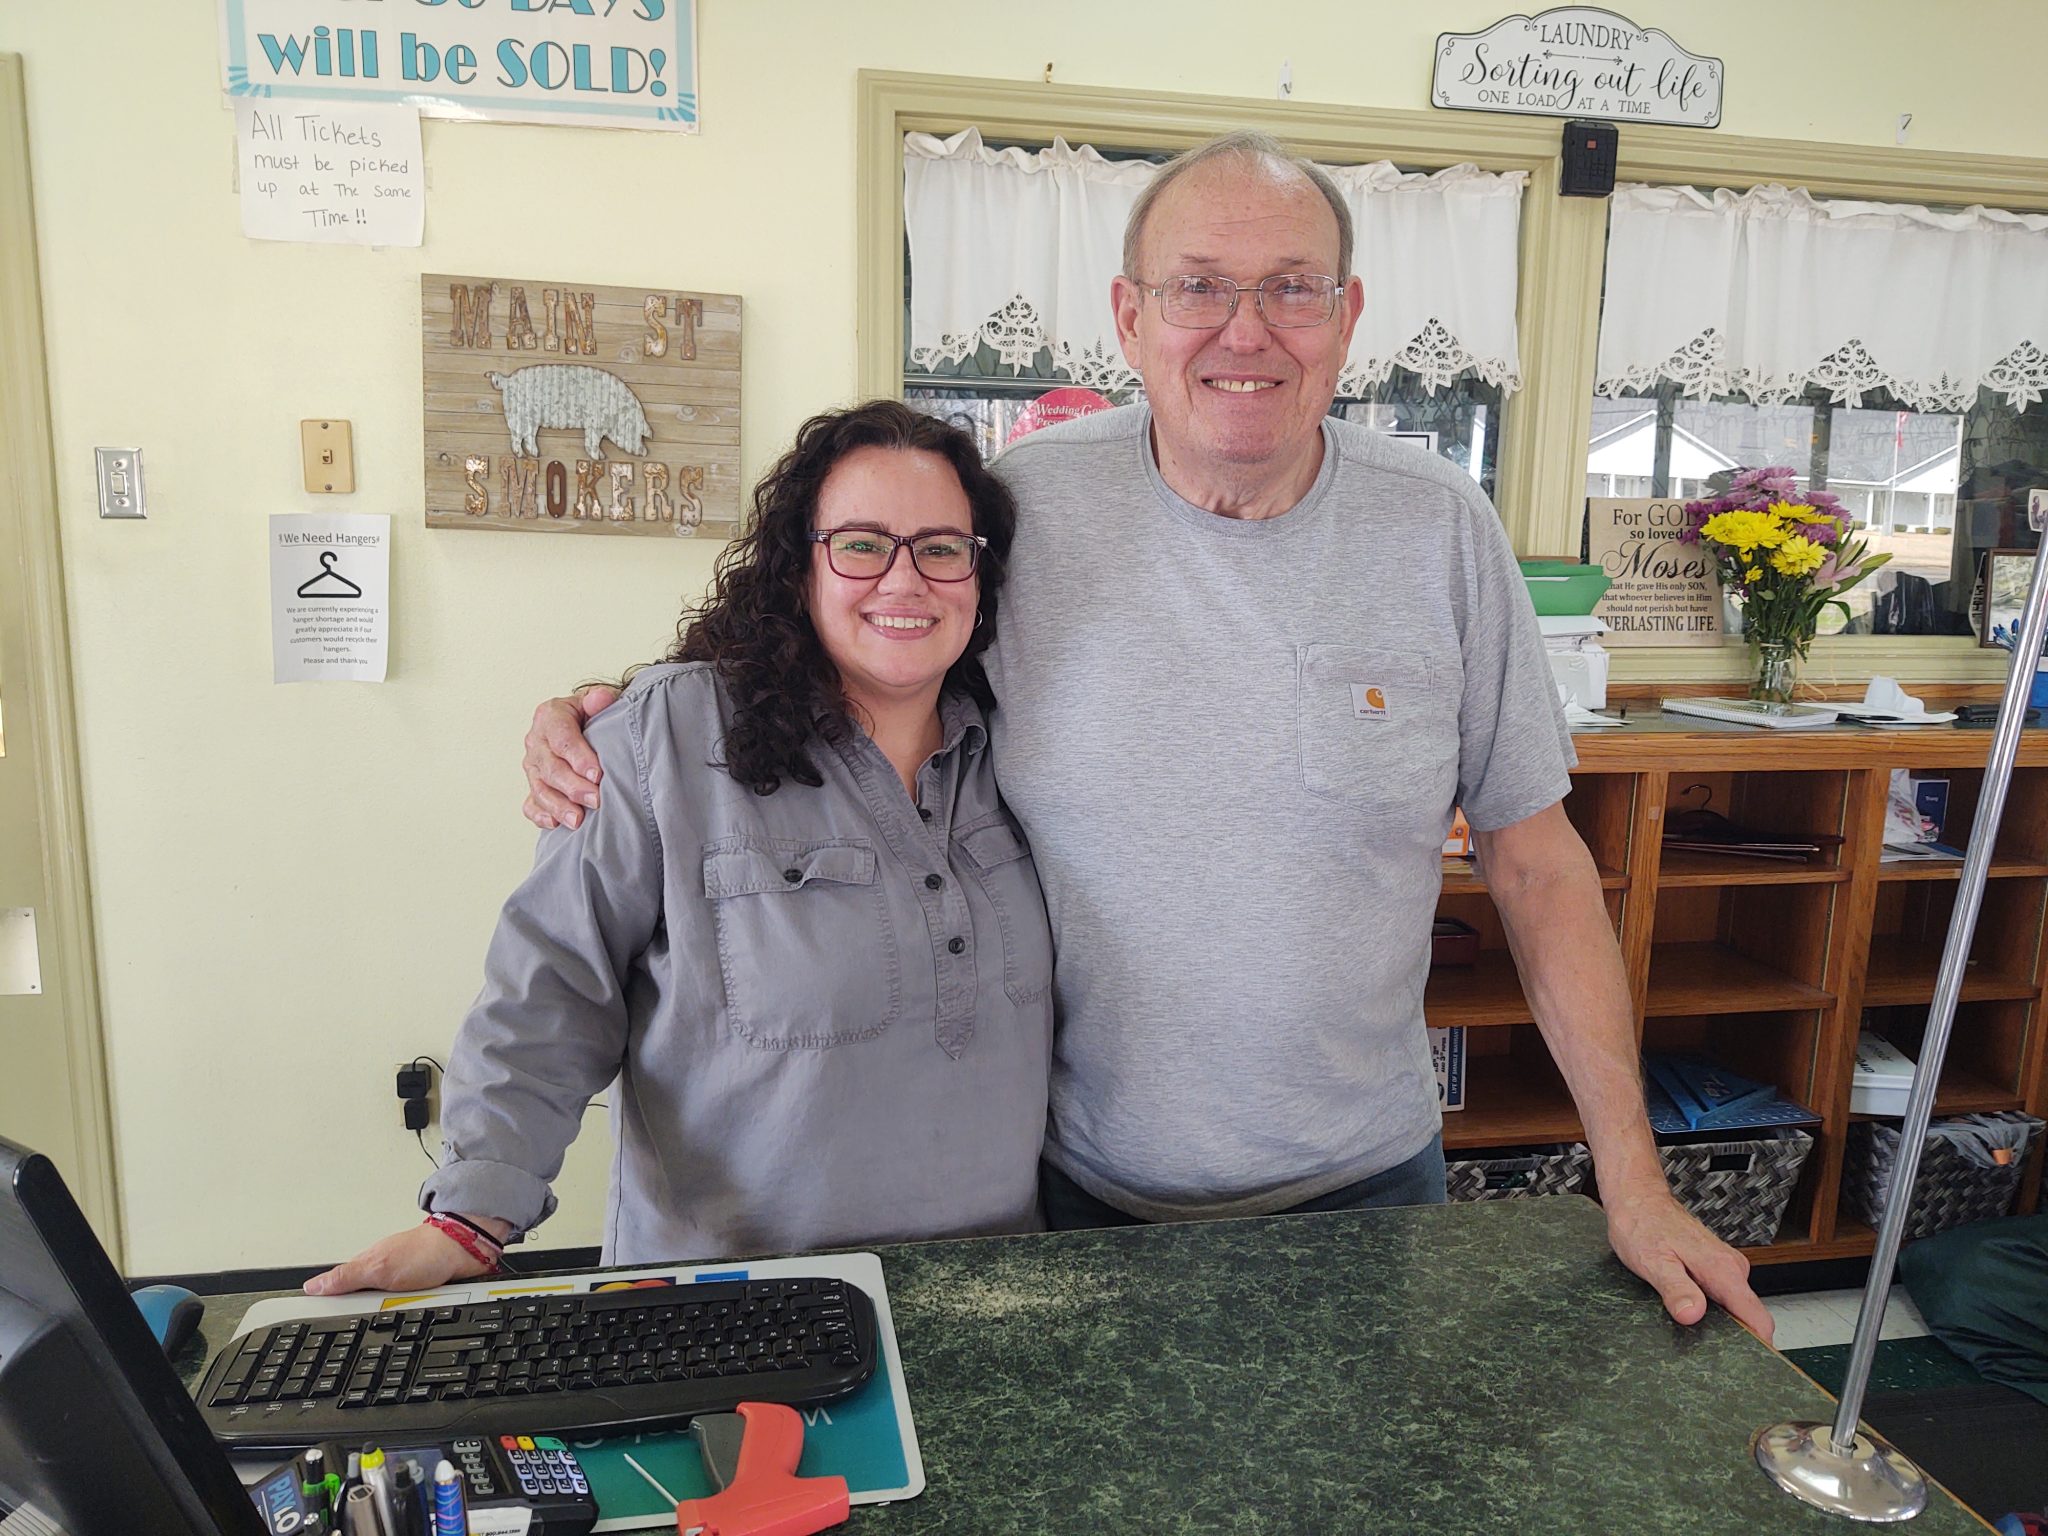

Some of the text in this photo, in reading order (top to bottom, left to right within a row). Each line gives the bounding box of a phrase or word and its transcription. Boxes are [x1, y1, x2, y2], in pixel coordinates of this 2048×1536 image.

[1540, 22, 1633, 50] LAUNDRY
[257, 26, 667, 97] will be SOLD!
[1458, 43, 1707, 112] Sorting out life
[1478, 90, 1651, 114] ONE LOAD AT A TIME
[252, 110, 382, 148] All Tickets
[255, 154, 408, 177] must be picked
[257, 181, 278, 198] up
[299, 182, 320, 196] at
[450, 284, 703, 360] MAIN ST
[1036, 403, 1106, 417] Wedding Gow
[464, 454, 704, 527] SMOKERS
[1613, 509, 1642, 526] For
[302, 532, 332, 543] Need
[1630, 530, 1645, 539] so
[1648, 528, 1683, 539] loved
[1600, 540, 1714, 579] Moses
[1609, 581, 1708, 592] hat He gave His only SON,
[1620, 593, 1652, 601] whoever
[1654, 593, 1685, 601] believes
[1687, 593, 1694, 601] in
[1696, 593, 1712, 601] Him
[308, 606, 338, 614] currently
[1606, 604, 1633, 612] should
[1649, 604, 1674, 613] perish
[1675, 604, 1688, 612] but
[1690, 604, 1708, 612] have
[292, 616, 314, 624] hanger
[316, 615, 344, 623] shortage
[1687, 615, 1718, 631] LIFE.
[295, 626, 317, 634] greatly
[318, 626, 353, 634] appreciate
